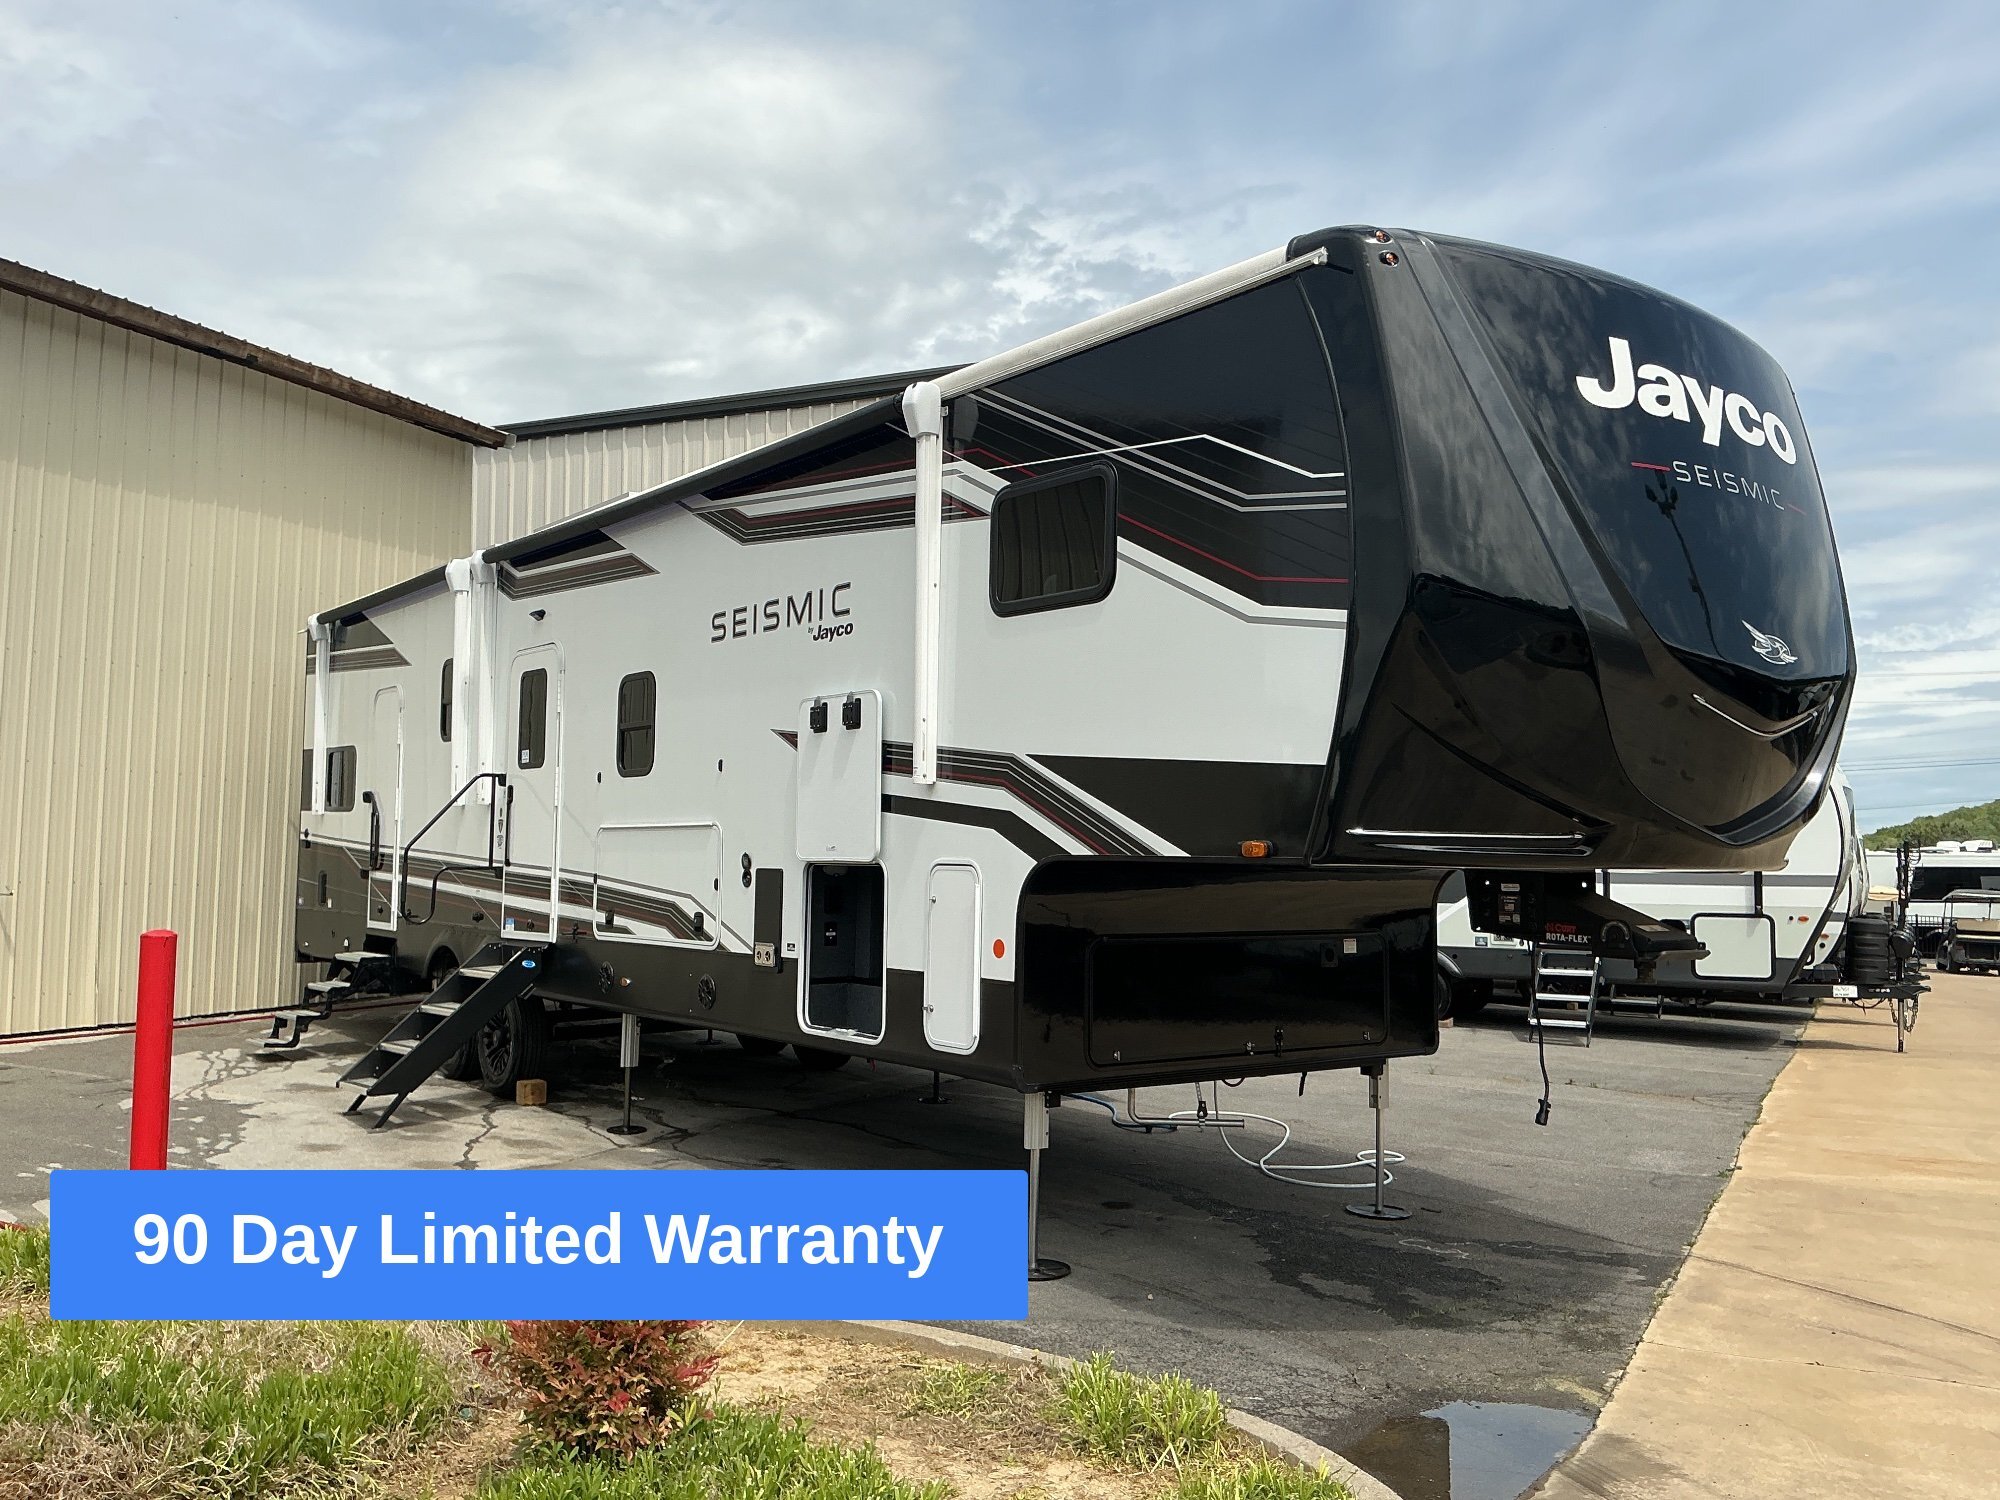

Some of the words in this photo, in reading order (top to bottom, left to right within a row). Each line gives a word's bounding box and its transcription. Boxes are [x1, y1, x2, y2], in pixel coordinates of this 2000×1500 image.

[1575, 336, 1797, 465] Jayco
[1672, 460, 1785, 510] SEISMIC
[710, 581, 852, 643] SEISMIC
[812, 622, 854, 642] Jayco
[1546, 932, 1588, 943] ROTA-FLEX
